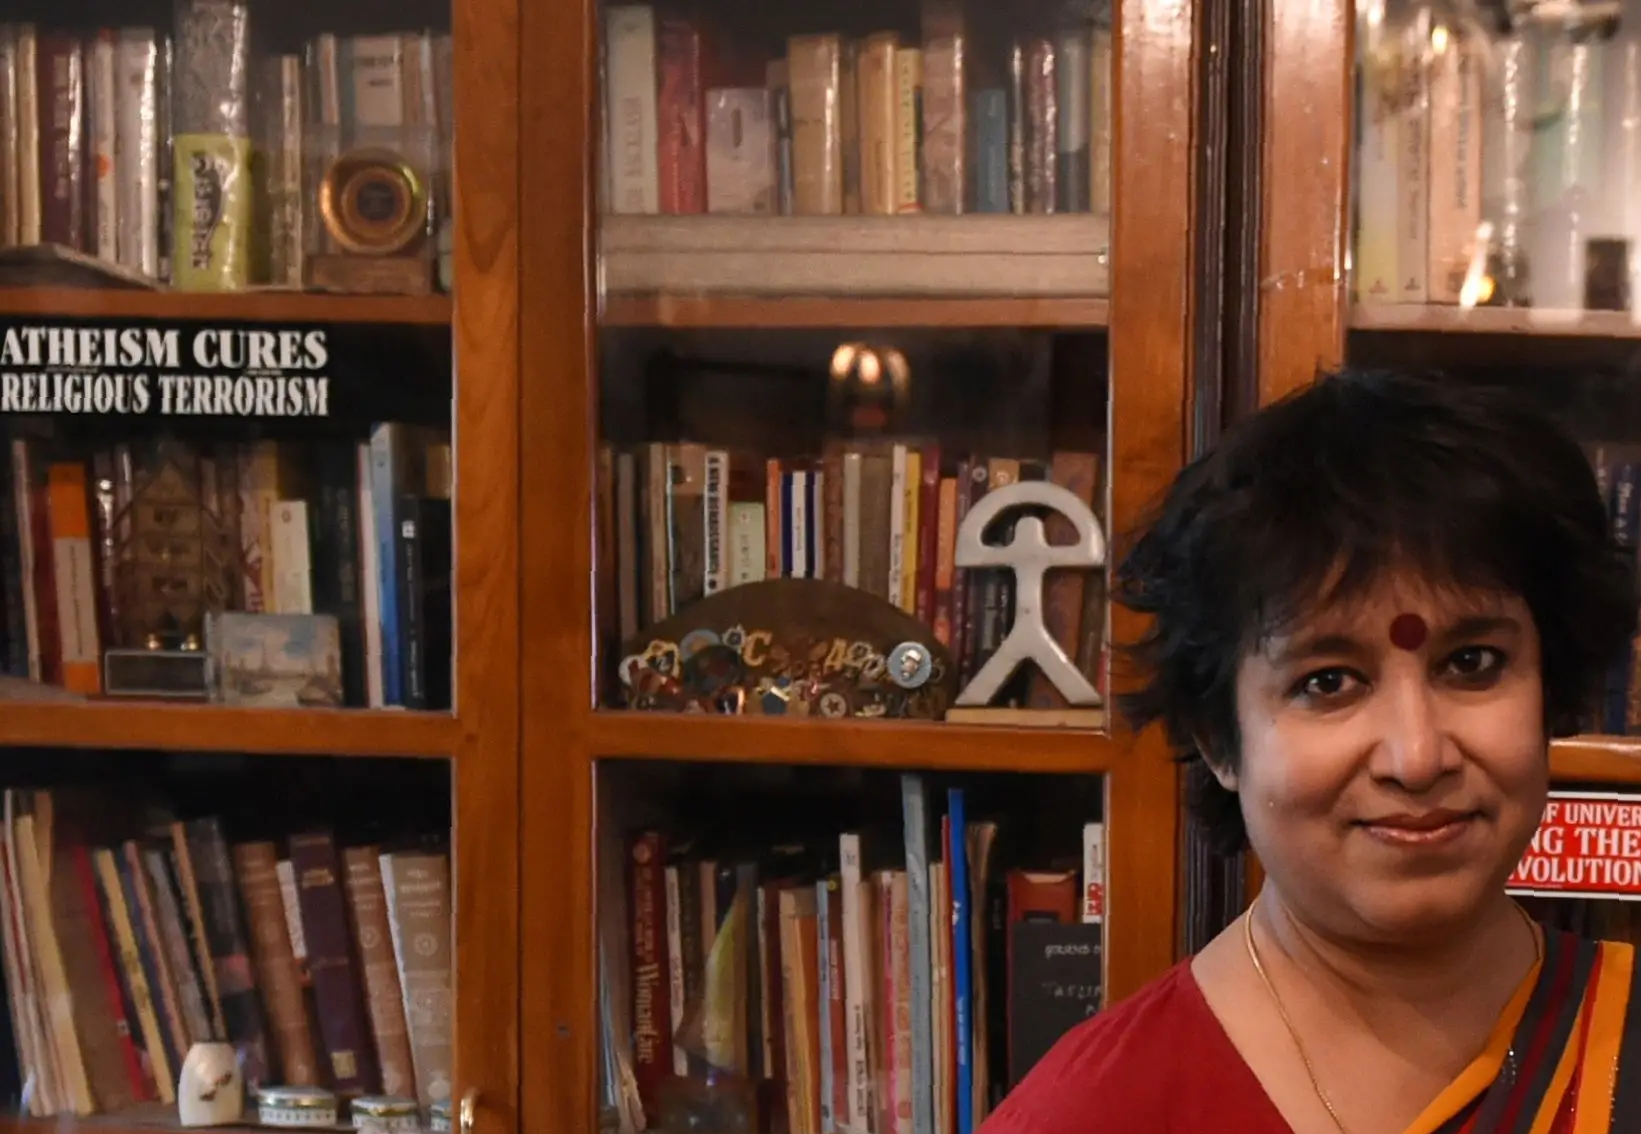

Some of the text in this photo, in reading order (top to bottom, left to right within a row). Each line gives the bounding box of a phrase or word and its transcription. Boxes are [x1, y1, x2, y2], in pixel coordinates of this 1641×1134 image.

[0, 326, 328, 369] ATHEISM CURES
[0, 372, 329, 416] RELIGIOUS TERRORISM
[1541, 802, 1560, 824] F
[1573, 826, 1641, 858] THE
